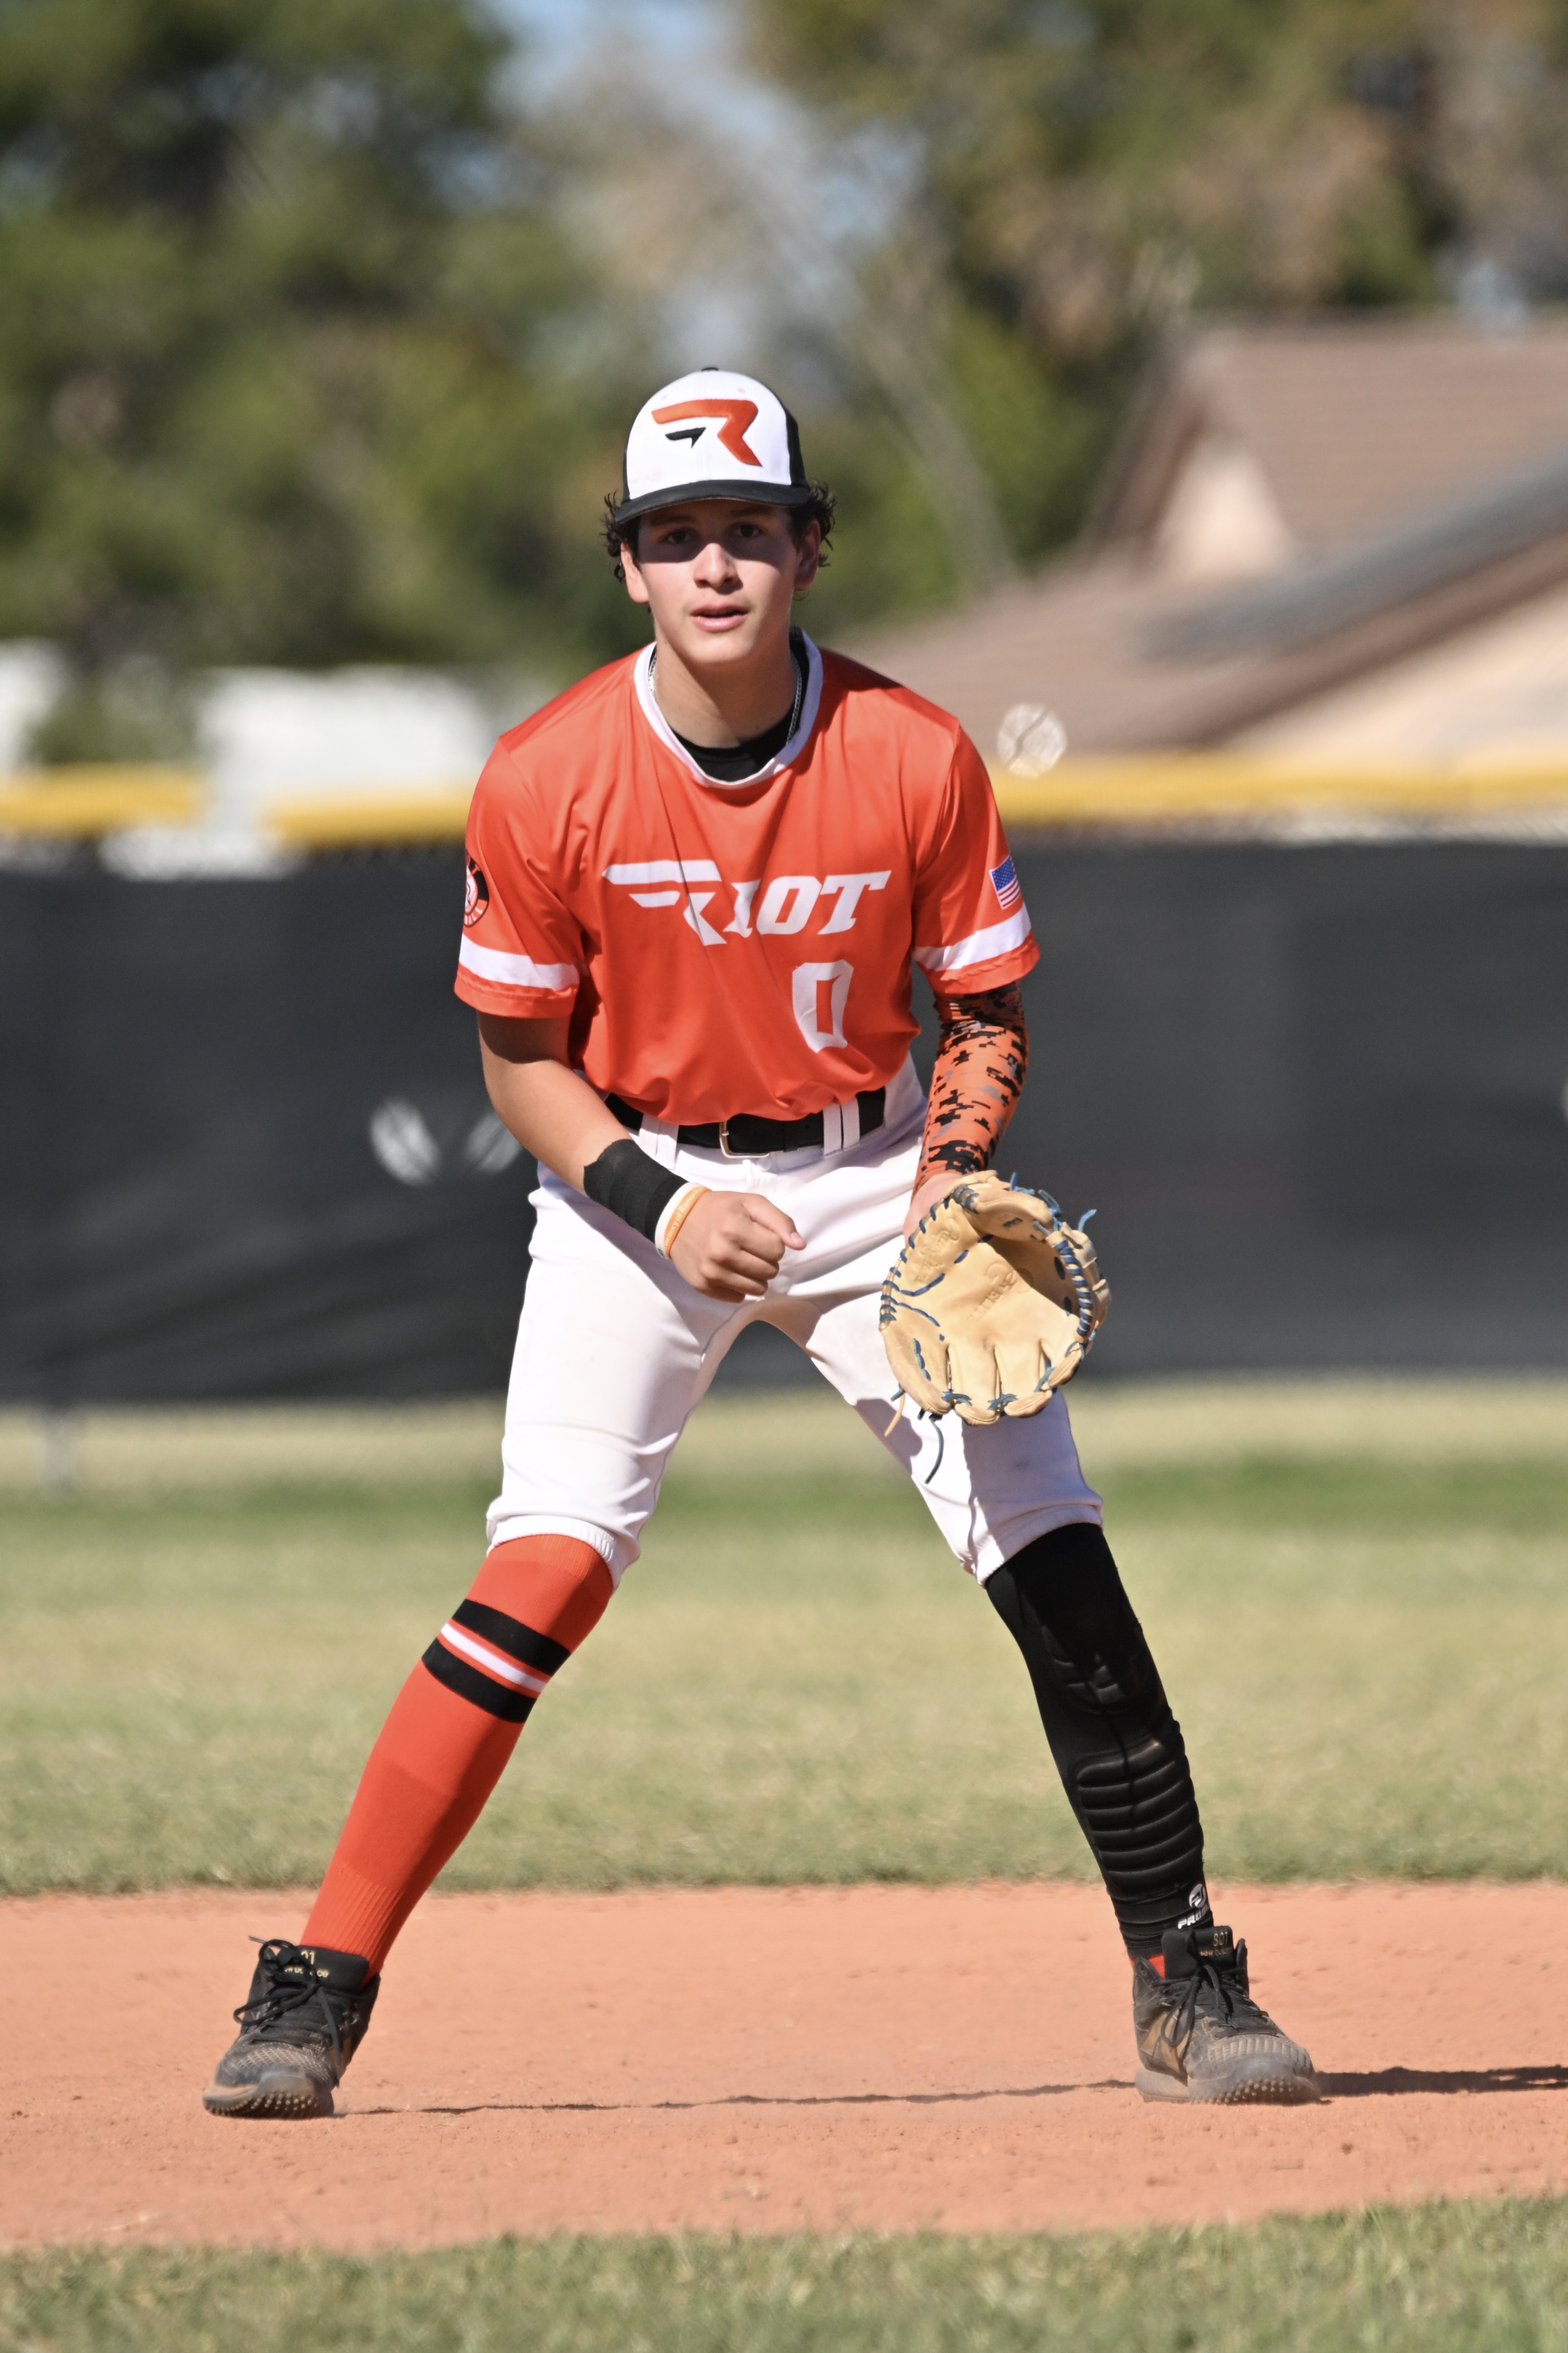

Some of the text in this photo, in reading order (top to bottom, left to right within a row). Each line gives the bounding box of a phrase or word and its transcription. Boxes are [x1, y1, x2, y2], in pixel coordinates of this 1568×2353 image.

[602, 859, 892, 946] RIOT
[792, 959, 854, 1053] 0
[675, 1212, 683, 1221] of
